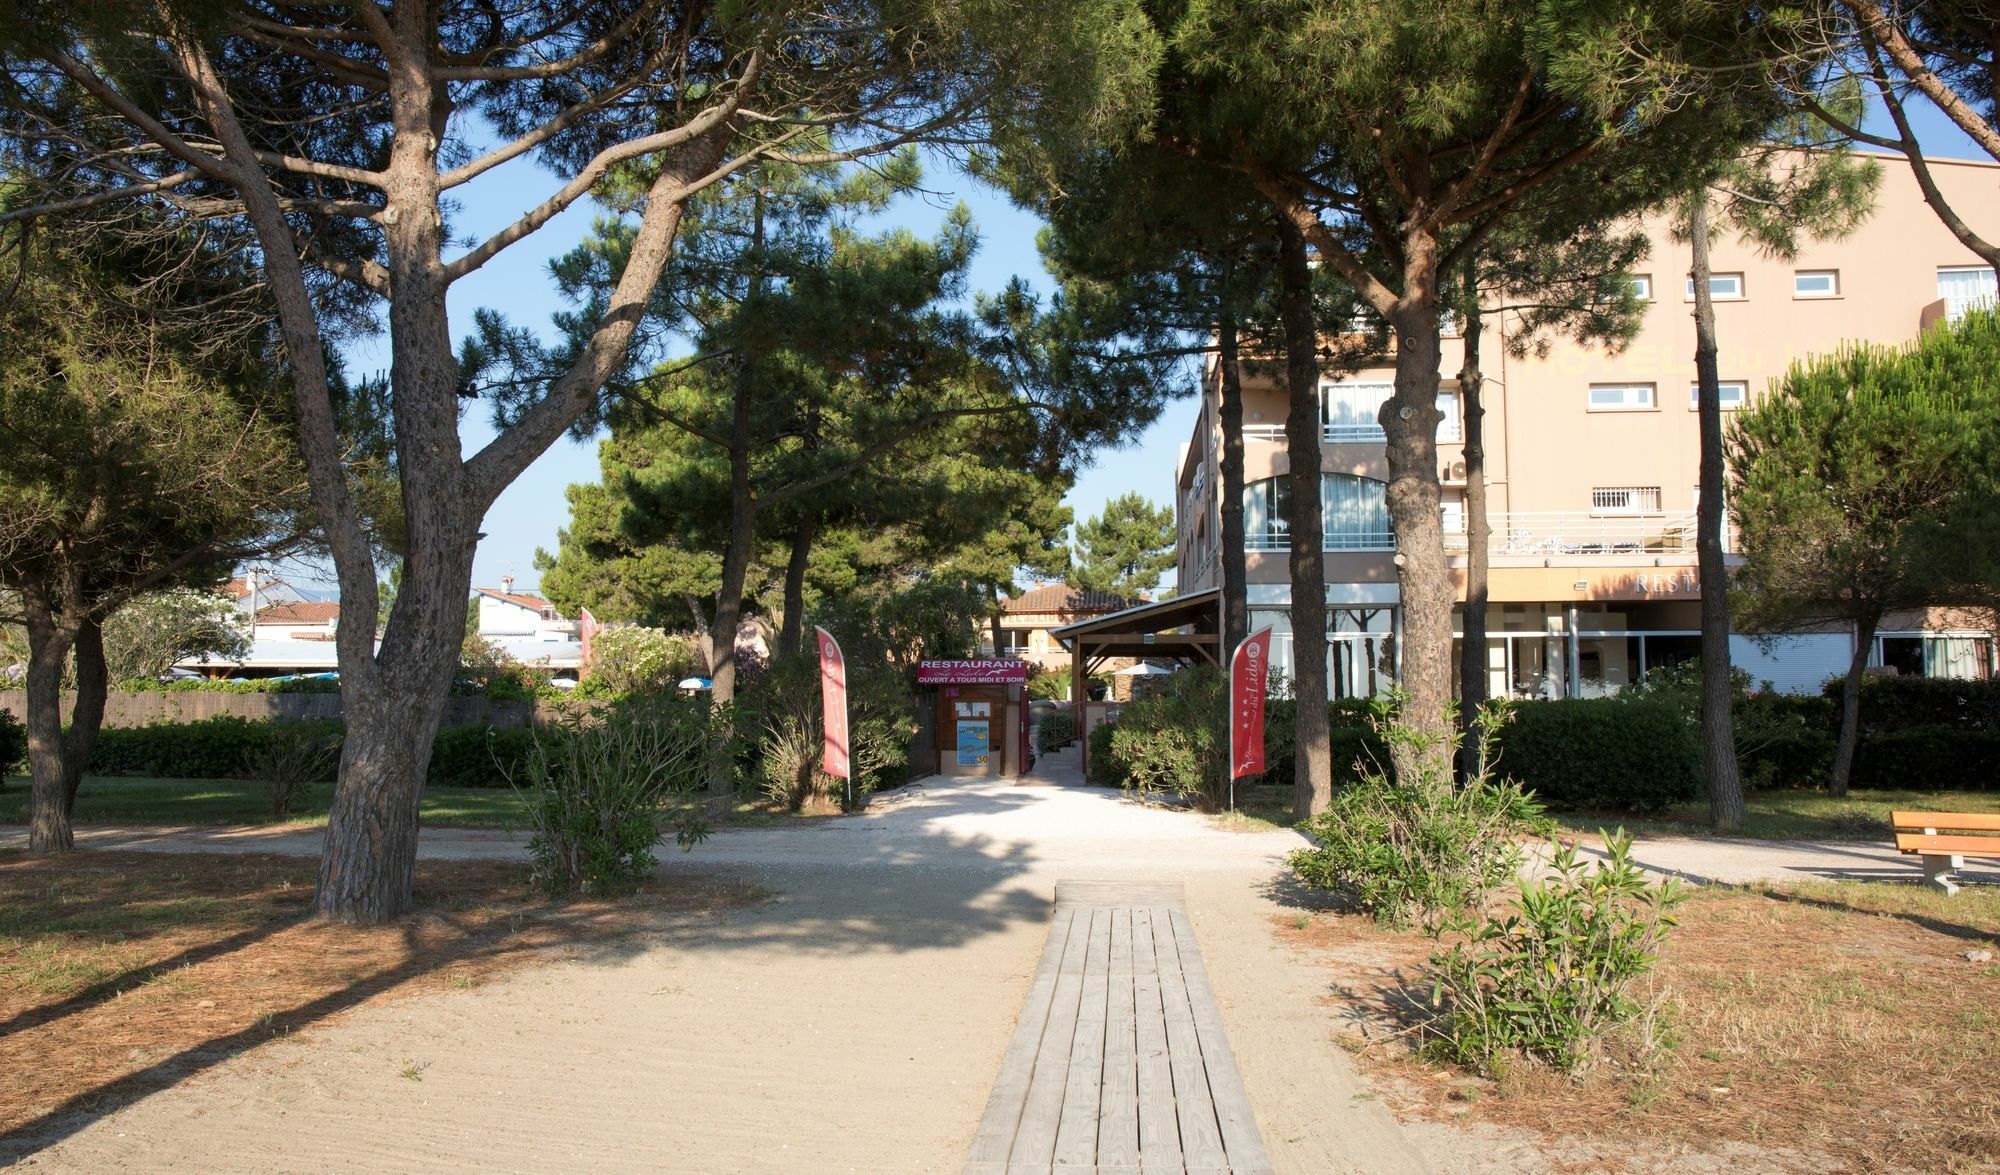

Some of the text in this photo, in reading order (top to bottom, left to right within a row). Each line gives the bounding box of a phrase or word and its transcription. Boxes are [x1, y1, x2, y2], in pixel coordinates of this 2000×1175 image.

[1635, 574, 1700, 593] REST
[921, 660, 1024, 669] RESTAURANT
[1245, 659, 1259, 694] Lido
